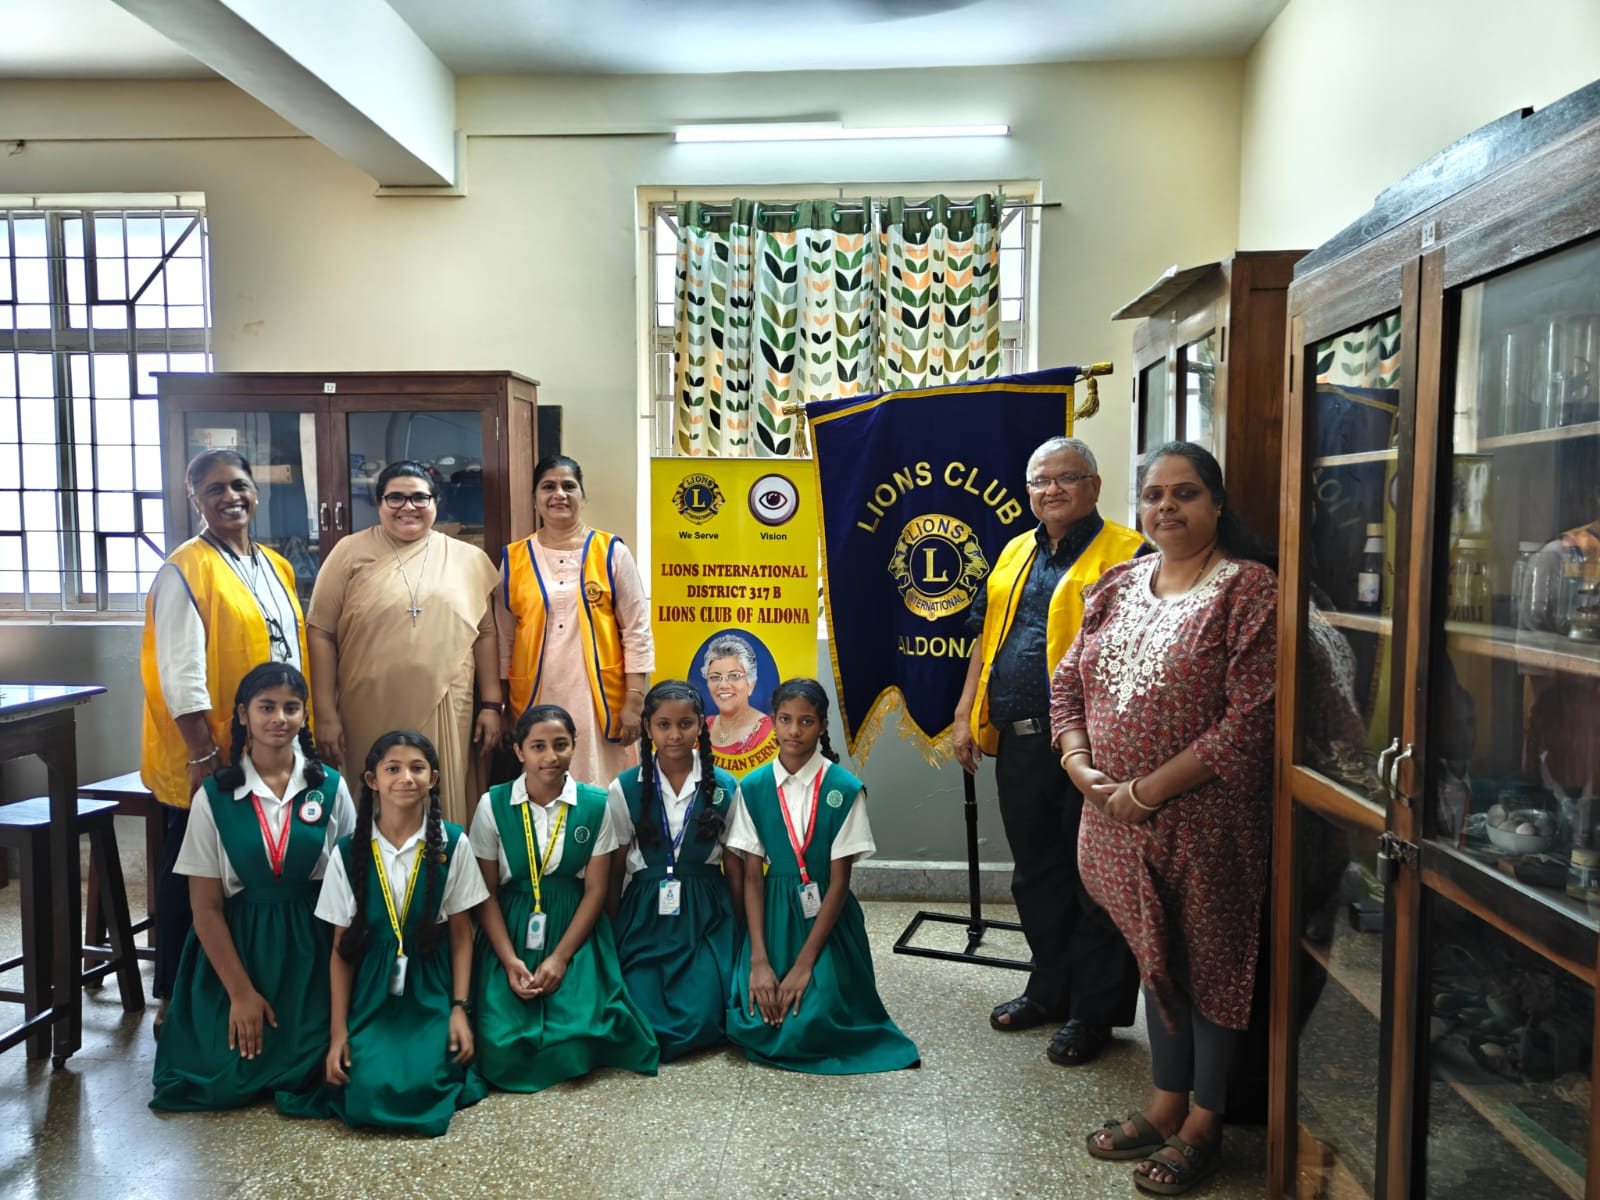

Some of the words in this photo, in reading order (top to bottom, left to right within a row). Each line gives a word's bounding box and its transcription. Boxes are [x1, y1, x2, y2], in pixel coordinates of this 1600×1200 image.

[1423, 226, 1433, 242] 14
[686, 475, 714, 487] LIONS
[692, 488, 706, 508] L
[857, 461, 933, 533] LIONS
[944, 461, 1023, 525] CLUB
[679, 531, 692, 539] We
[694, 531, 719, 539] Serve
[760, 532, 787, 540] Vision
[906, 518, 965, 541] LIONS
[661, 563, 699, 576] LIONS
[702, 564, 808, 578] INTERNATIONAL
[922, 547, 949, 582] L
[687, 585, 747, 598] DISTRICT
[749, 587, 770, 600] 317
[773, 586, 781, 598] B
[658, 606, 696, 622] LIONS
[700, 606, 732, 623] CLUB
[736, 607, 753, 623] OF
[757, 608, 810, 624] ALDONA
